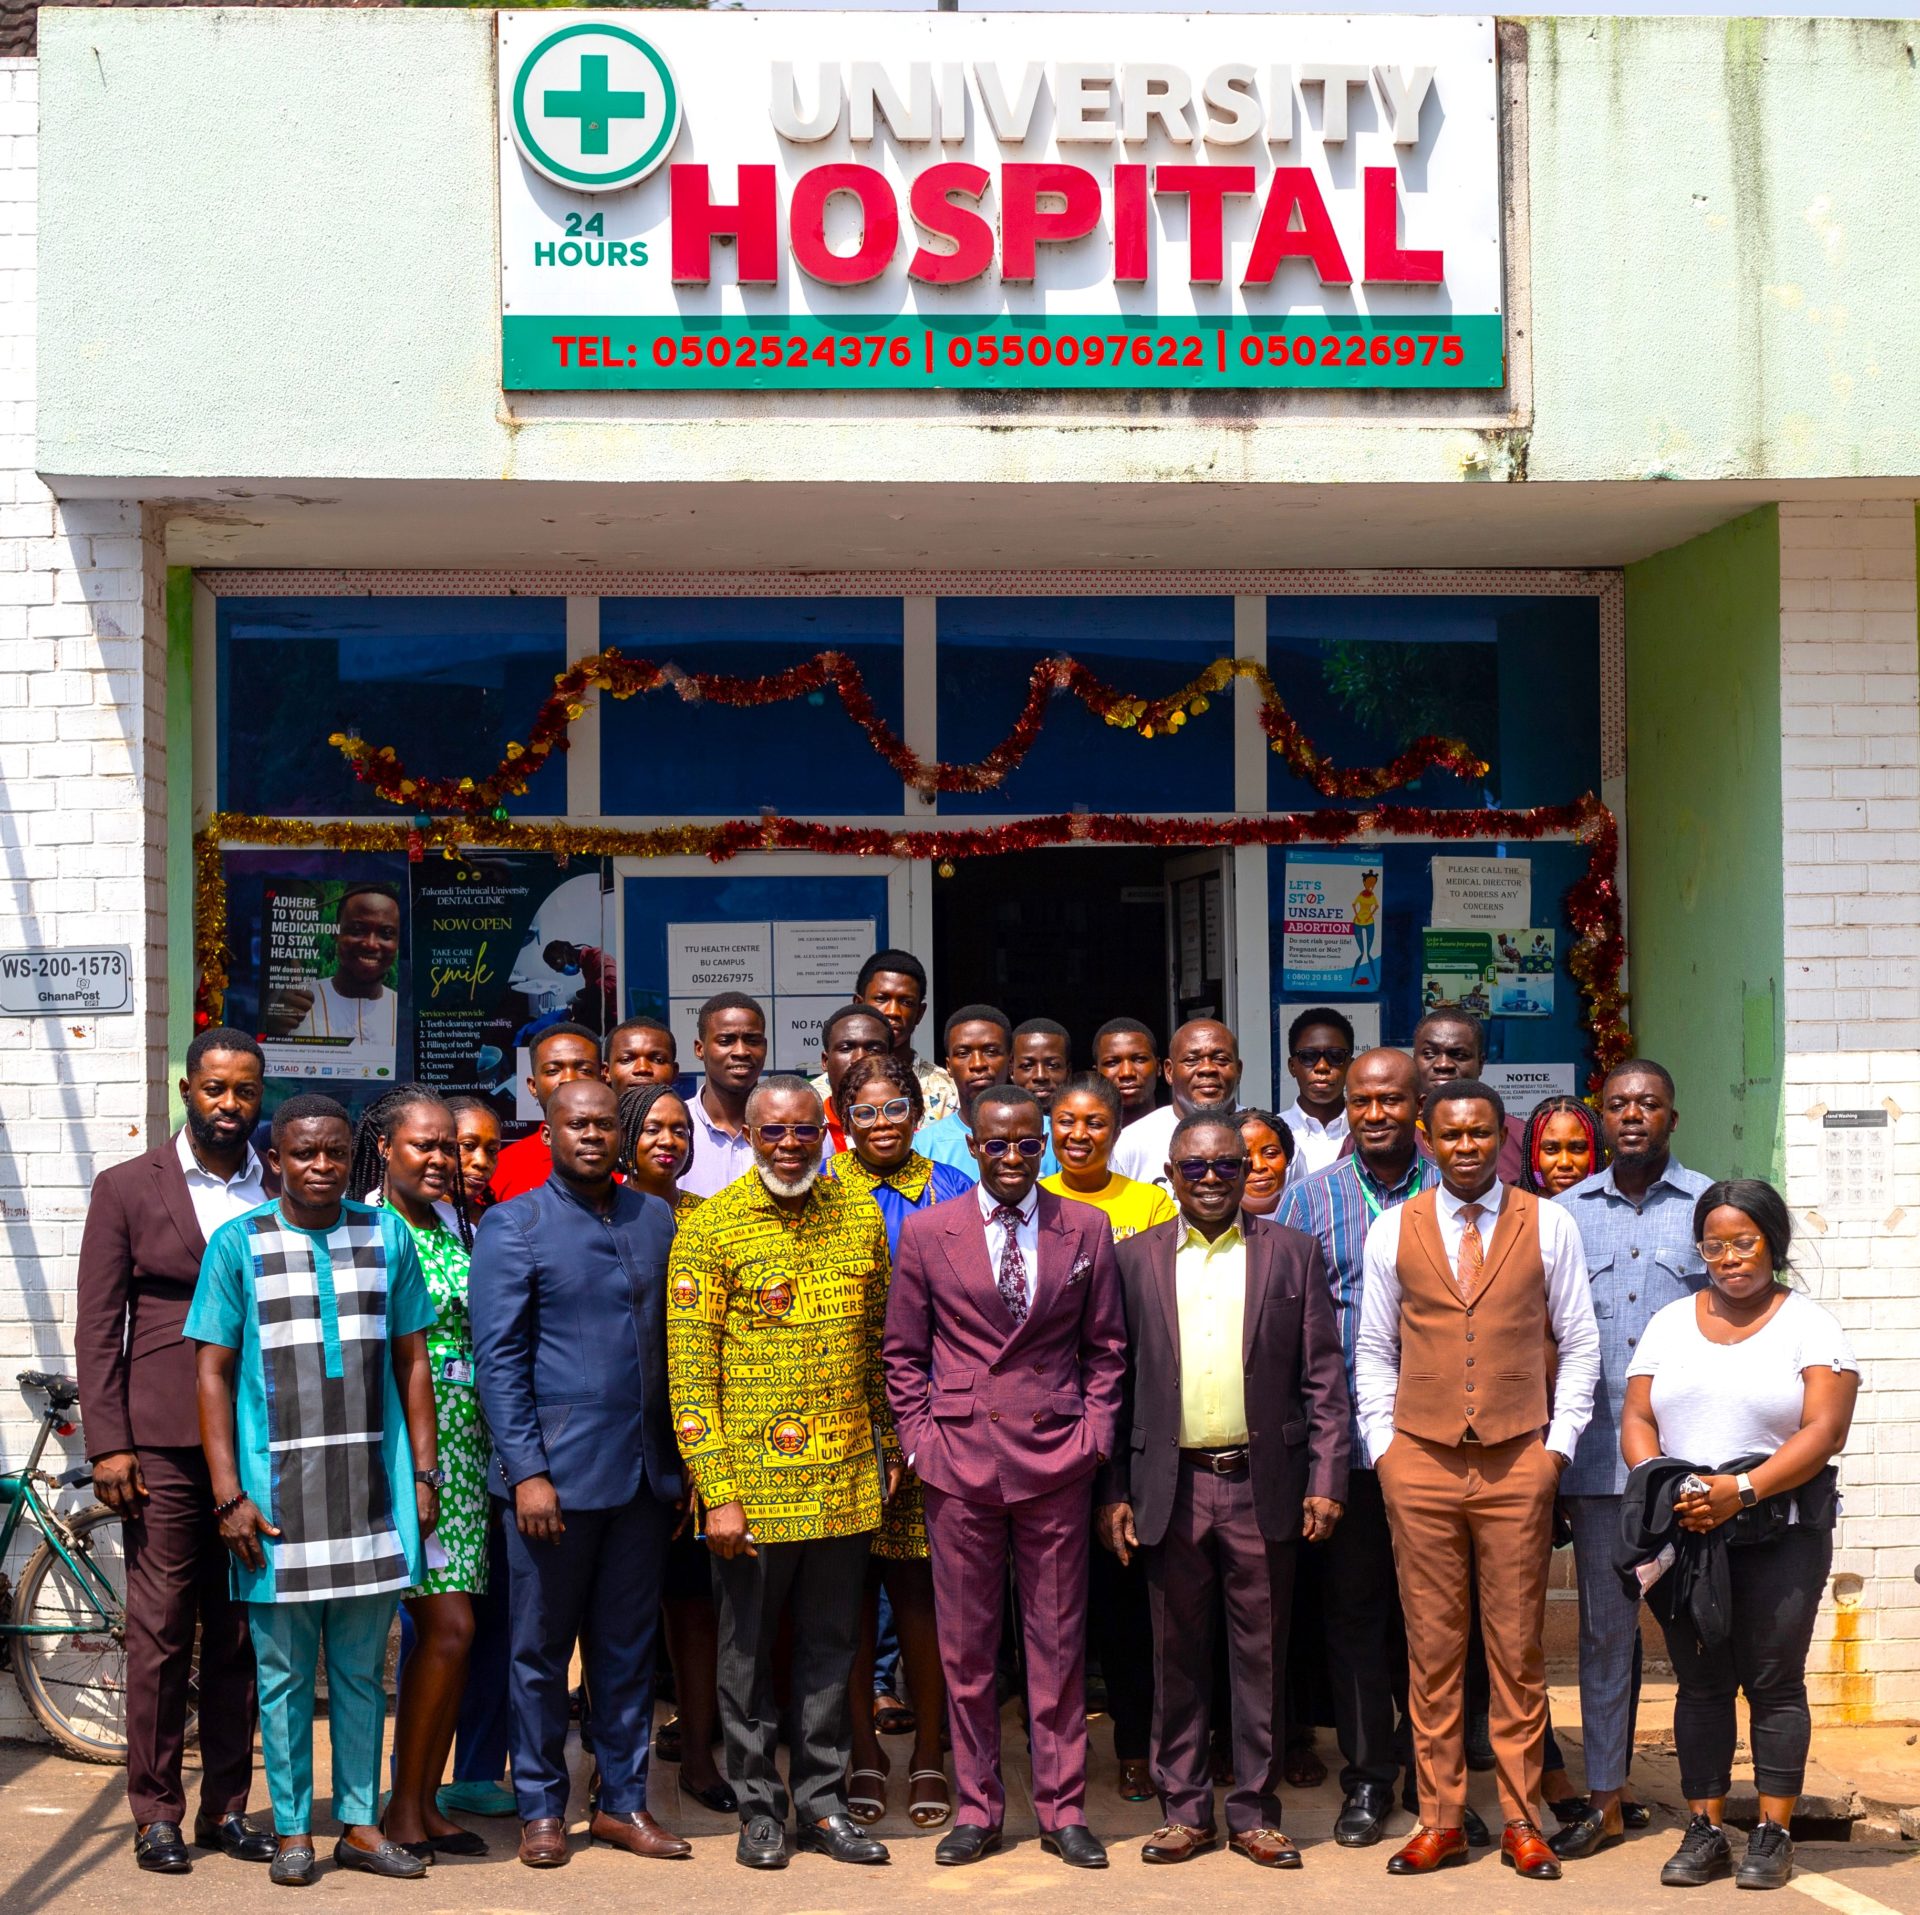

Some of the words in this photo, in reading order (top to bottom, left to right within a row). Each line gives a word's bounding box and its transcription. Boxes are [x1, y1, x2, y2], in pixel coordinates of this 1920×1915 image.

[770, 61, 1437, 147] UNIVERSITY
[565, 212, 604, 237] 24
[670, 162, 1444, 288] HOSPITAL
[535, 242, 648, 267] HOURS
[552, 336, 637, 368] TEL:
[652, 336, 911, 368] 0502524376
[948, 336, 1204, 367] 0550097622
[1240, 336, 1465, 367] 050226975
[1448, 865, 1479, 874] PLEASE
[1481, 866, 1502, 874] CALL
[1504, 867, 1520, 875] THE
[1289, 880, 1322, 890] LET'S
[1445, 878, 1481, 886] MEDICAL
[1483, 879, 1522, 887] DIRECTOR
[421, 887, 454, 896] Takoradi
[455, 886, 490, 895] Technical
[491, 886, 529, 896] University
[1462, 890, 1499, 898] ADDRESS
[1500, 890, 1519, 899] ANY
[272, 896, 317, 909] ADHERE
[437, 896, 473, 905] DENTAL
[474, 896, 505, 905] CLINIC
[1463, 902, 1504, 911] CONCERNS
[272, 908, 286, 920] TO
[289, 909, 319, 921] YOUR
[1288, 907, 1344, 919] UNSAFE
[271, 921, 341, 935] MEDICATION
[433, 919, 470, 931] NOW
[472, 918, 512, 930] OPEN
[1287, 922, 1351, 933] ABORTION
[271, 934, 285, 946] TO
[288, 935, 315, 947] STAY
[270, 947, 320, 960] HEALTHY.
[431, 949, 451, 957] TAKE
[452, 948, 473, 956] CARE
[701, 945, 730, 953] HEALTH
[731, 944, 760, 952] CENTRE
[1289, 946, 1318, 954] Pregnant
[444, 957, 468, 965] YOUR
[712, 958, 745, 966] CAMPUS
[2, 956, 121, 978] WS-200-1573
[269, 965, 282, 973] HIV
[430, 941, 494, 1001] smile
[692, 973, 754, 984] 0502267975
[38, 989, 100, 1002] GhanaPost
[419, 1010, 446, 1018] Services
[458, 1010, 485, 1019] provide
[426, 1020, 445, 1028] Teeth
[445, 1020, 474, 1029] cleaning
[483, 1019, 512, 1029] washing
[791, 1020, 808, 1029] NO
[426, 1030, 445, 1038] Teeth
[445, 1030, 480, 1039] whitening
[426, 1041, 447, 1050] Filling
[447, 1040, 456, 1048] of
[803, 1037, 819, 1047] NO
[426, 1051, 456, 1059] Removal
[457, 1051, 465, 1059] of
[465, 1051, 483, 1059] teeth
[273, 1065, 300, 1073] USAID
[426, 1062, 455, 1070] Crowns
[427, 1072, 449, 1080] Braces
[1506, 1073, 1551, 1082] NOTICE
[471, 1082, 479, 1090] of
[799, 1262, 871, 1287] TAKORADI
